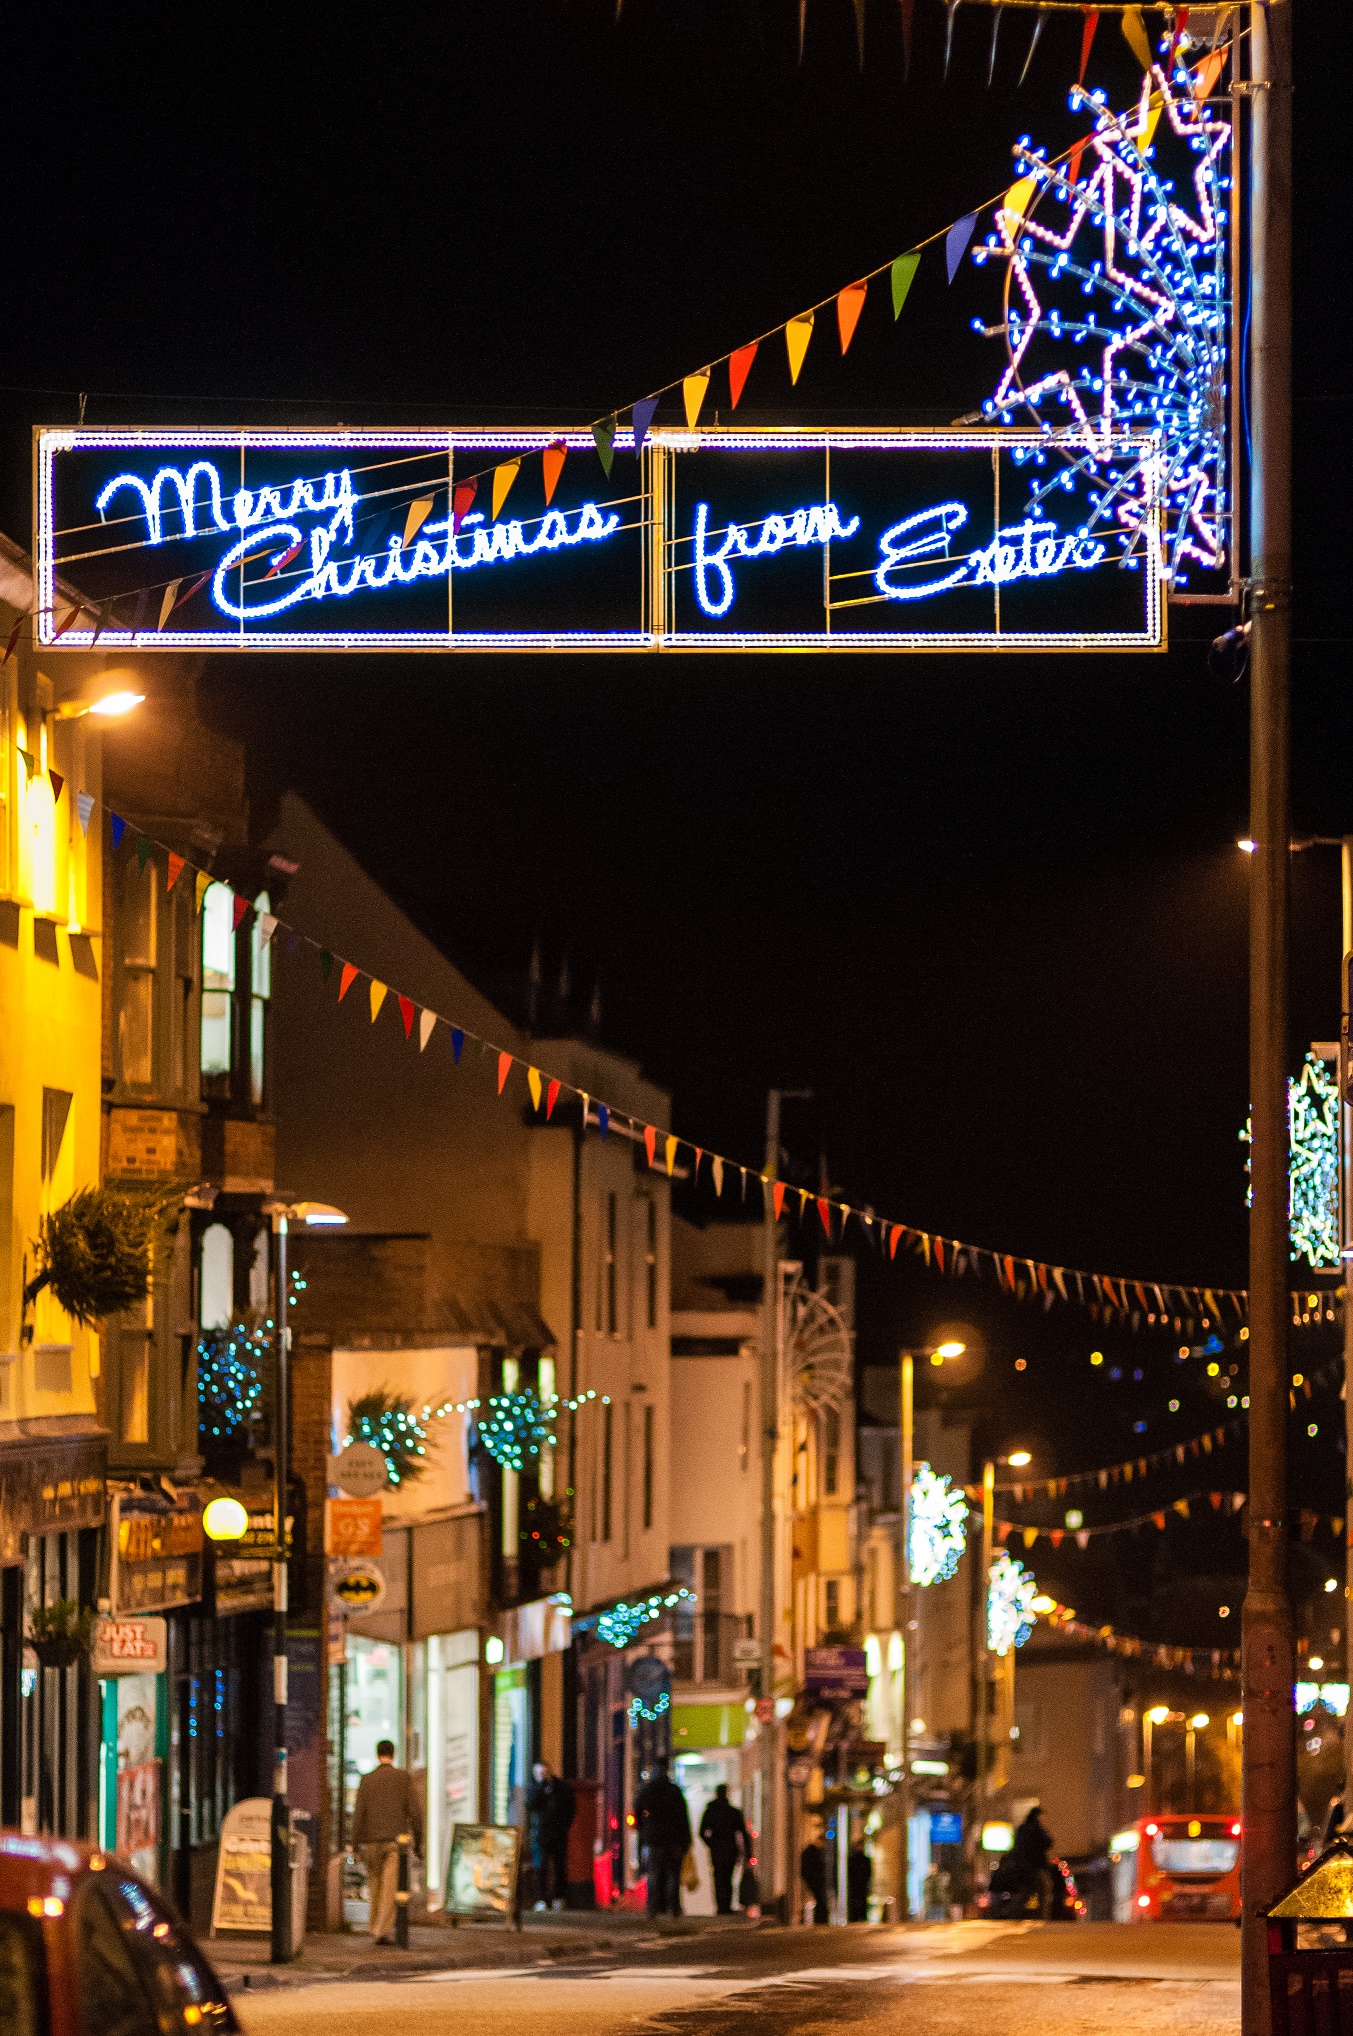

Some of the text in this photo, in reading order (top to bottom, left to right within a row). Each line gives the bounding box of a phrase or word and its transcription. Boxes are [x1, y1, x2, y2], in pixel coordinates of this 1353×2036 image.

[96, 460, 358, 546] Merry
[211, 502, 620, 620] Christmas
[693, 501, 1106, 617] from Exeter
[101, 1623, 147, 1641] JUST
[111, 1640, 144, 1658] EAT
